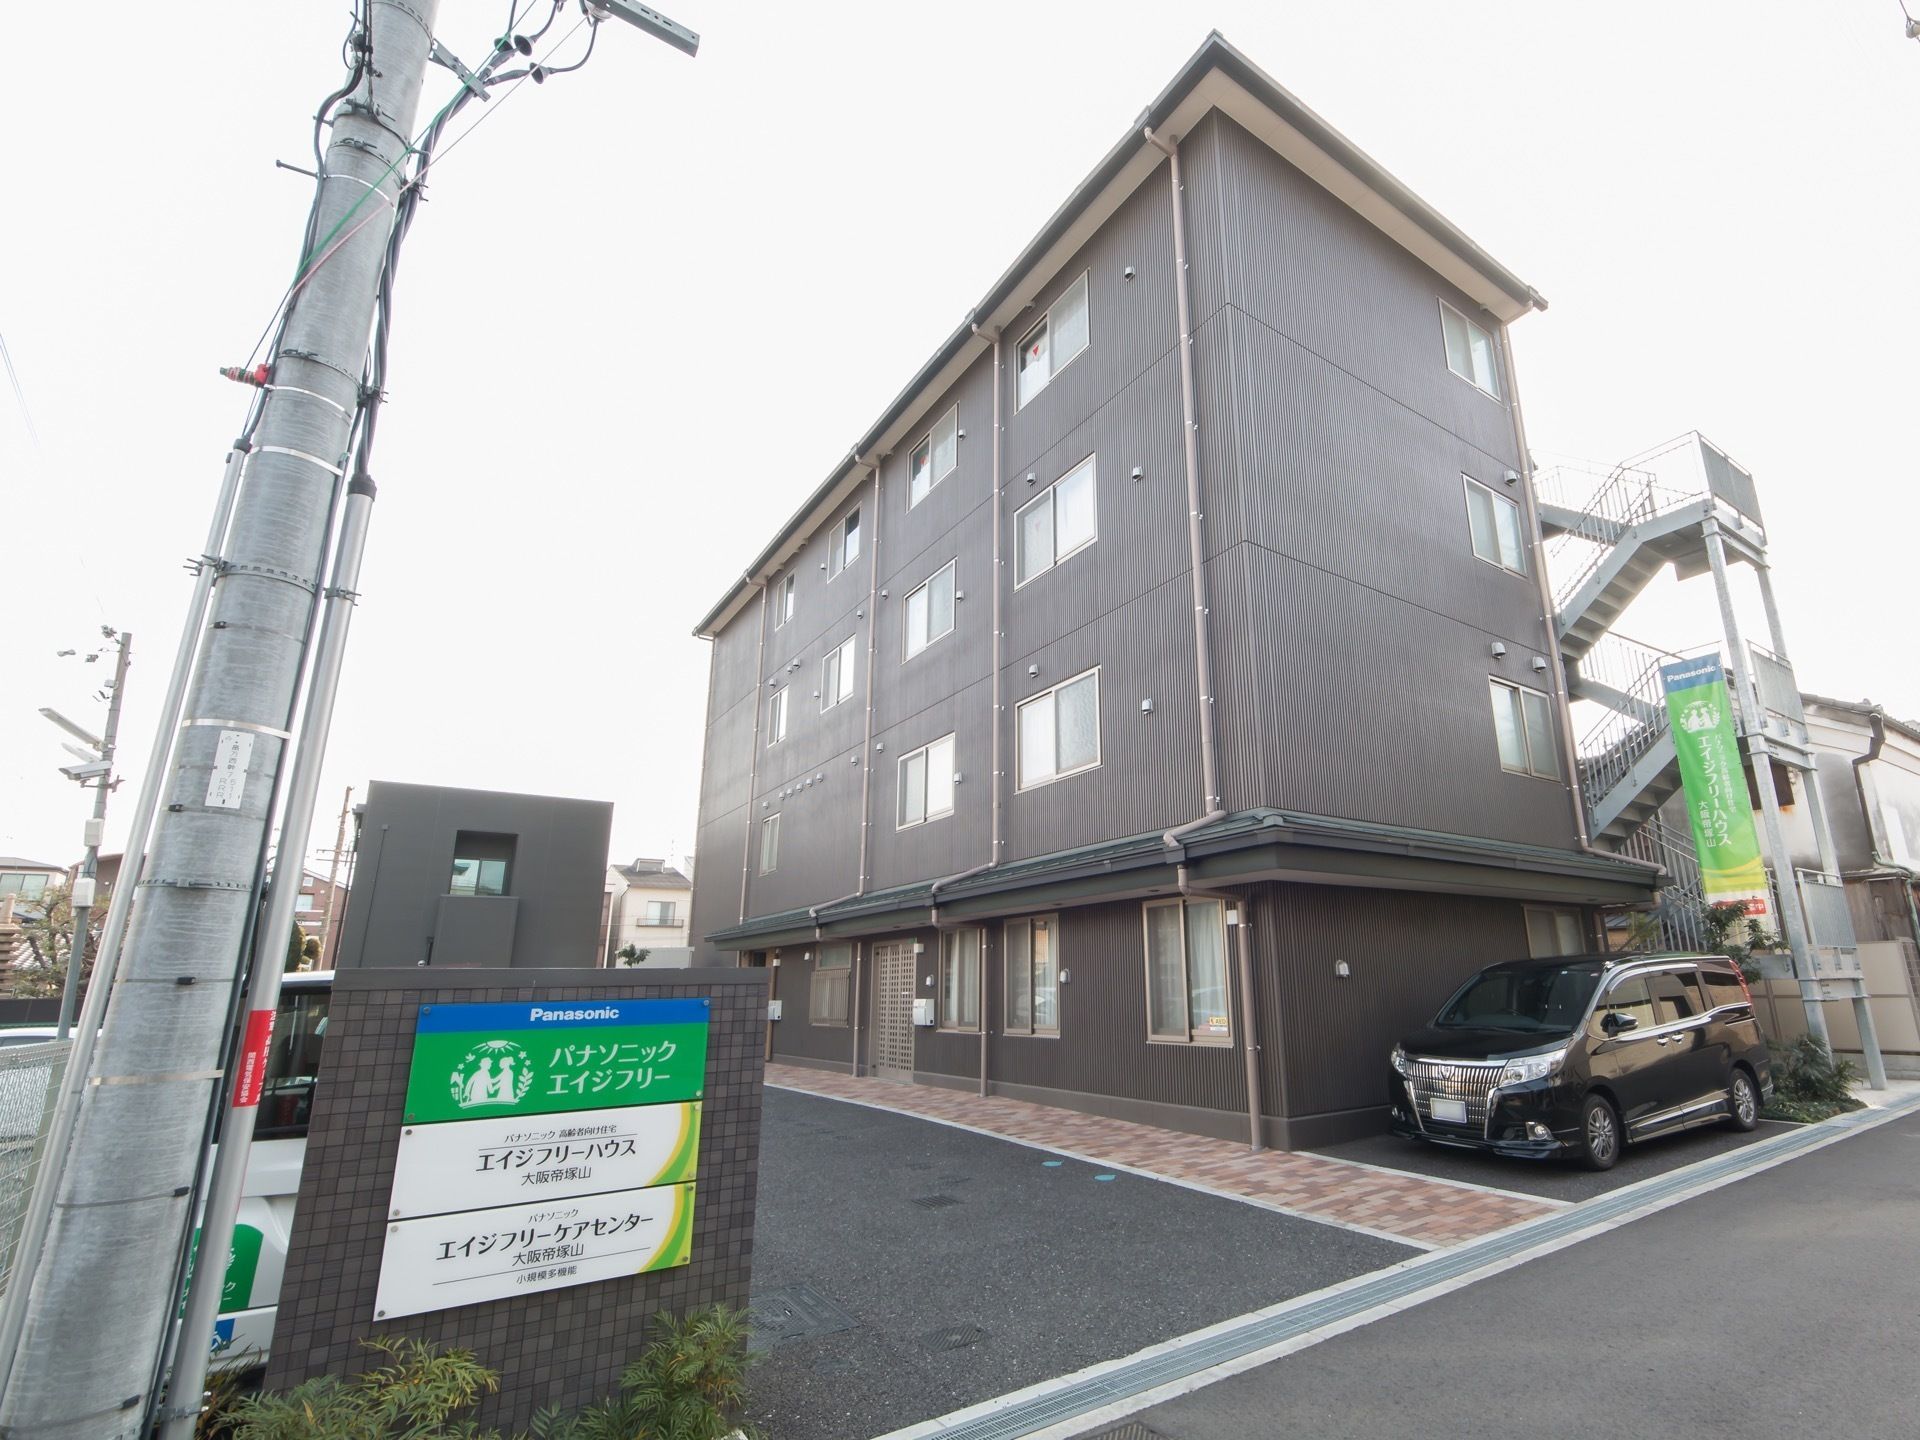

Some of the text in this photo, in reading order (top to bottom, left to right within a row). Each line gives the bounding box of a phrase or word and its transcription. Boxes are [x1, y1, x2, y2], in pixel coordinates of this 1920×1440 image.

[1666, 665, 1717, 682] Panasonic
[1698, 735, 1732, 846] エイジフリーハウス
[530, 1006, 620, 1022] Panasonic
[549, 1040, 677, 1068] パナソニック
[546, 1068, 671, 1095] エイジフリー
[504, 1124, 617, 1144] パナソニック 高齢者向け住宅
[475, 1139, 637, 1172] エイジフリーハウス
[521, 1165, 593, 1186] 大阪帝塚山
[528, 1208, 579, 1223] パナソニック
[435, 1213, 654, 1262] エイジフリーケアセンター
[511, 1243, 585, 1266] 大阪帝塚山
[516, 1265, 577, 1285] 小規模多機能
